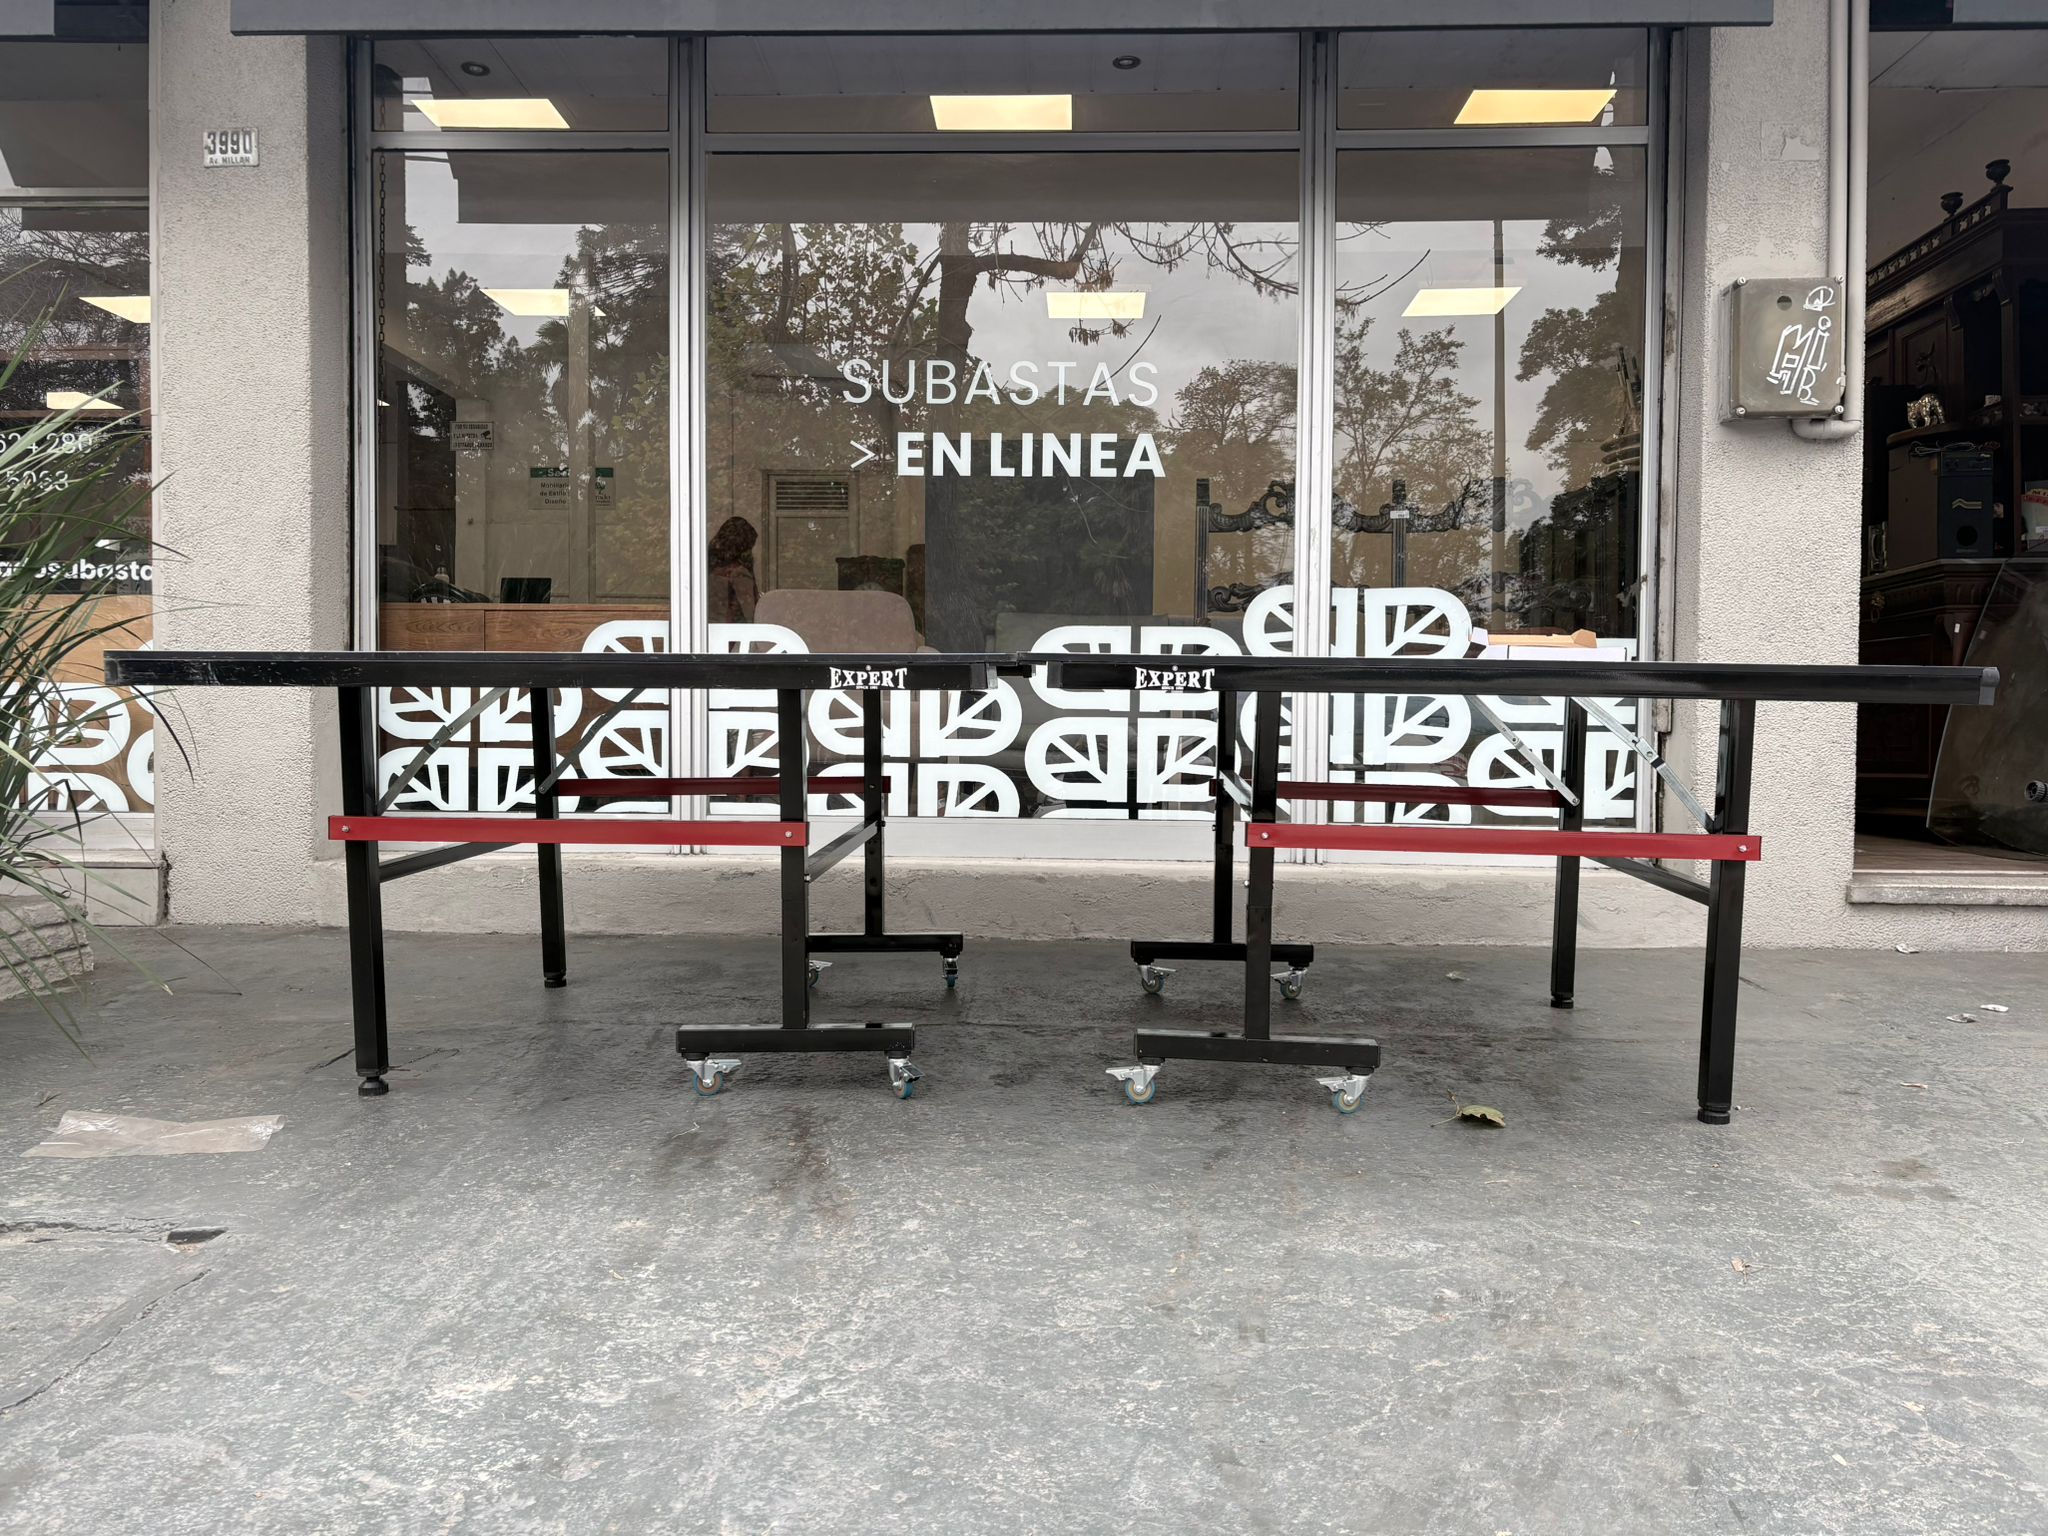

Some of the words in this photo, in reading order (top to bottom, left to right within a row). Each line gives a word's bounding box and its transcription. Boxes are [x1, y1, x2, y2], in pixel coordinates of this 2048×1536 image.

[207, 130, 252, 155] 3990
[842, 358, 1158, 407] SUBASTAS
[897, 432, 971, 477] EN
[990, 432, 1166, 478] LINEA
[829, 666, 908, 689] EXPERT
[1134, 666, 1216, 691] EXPERT
